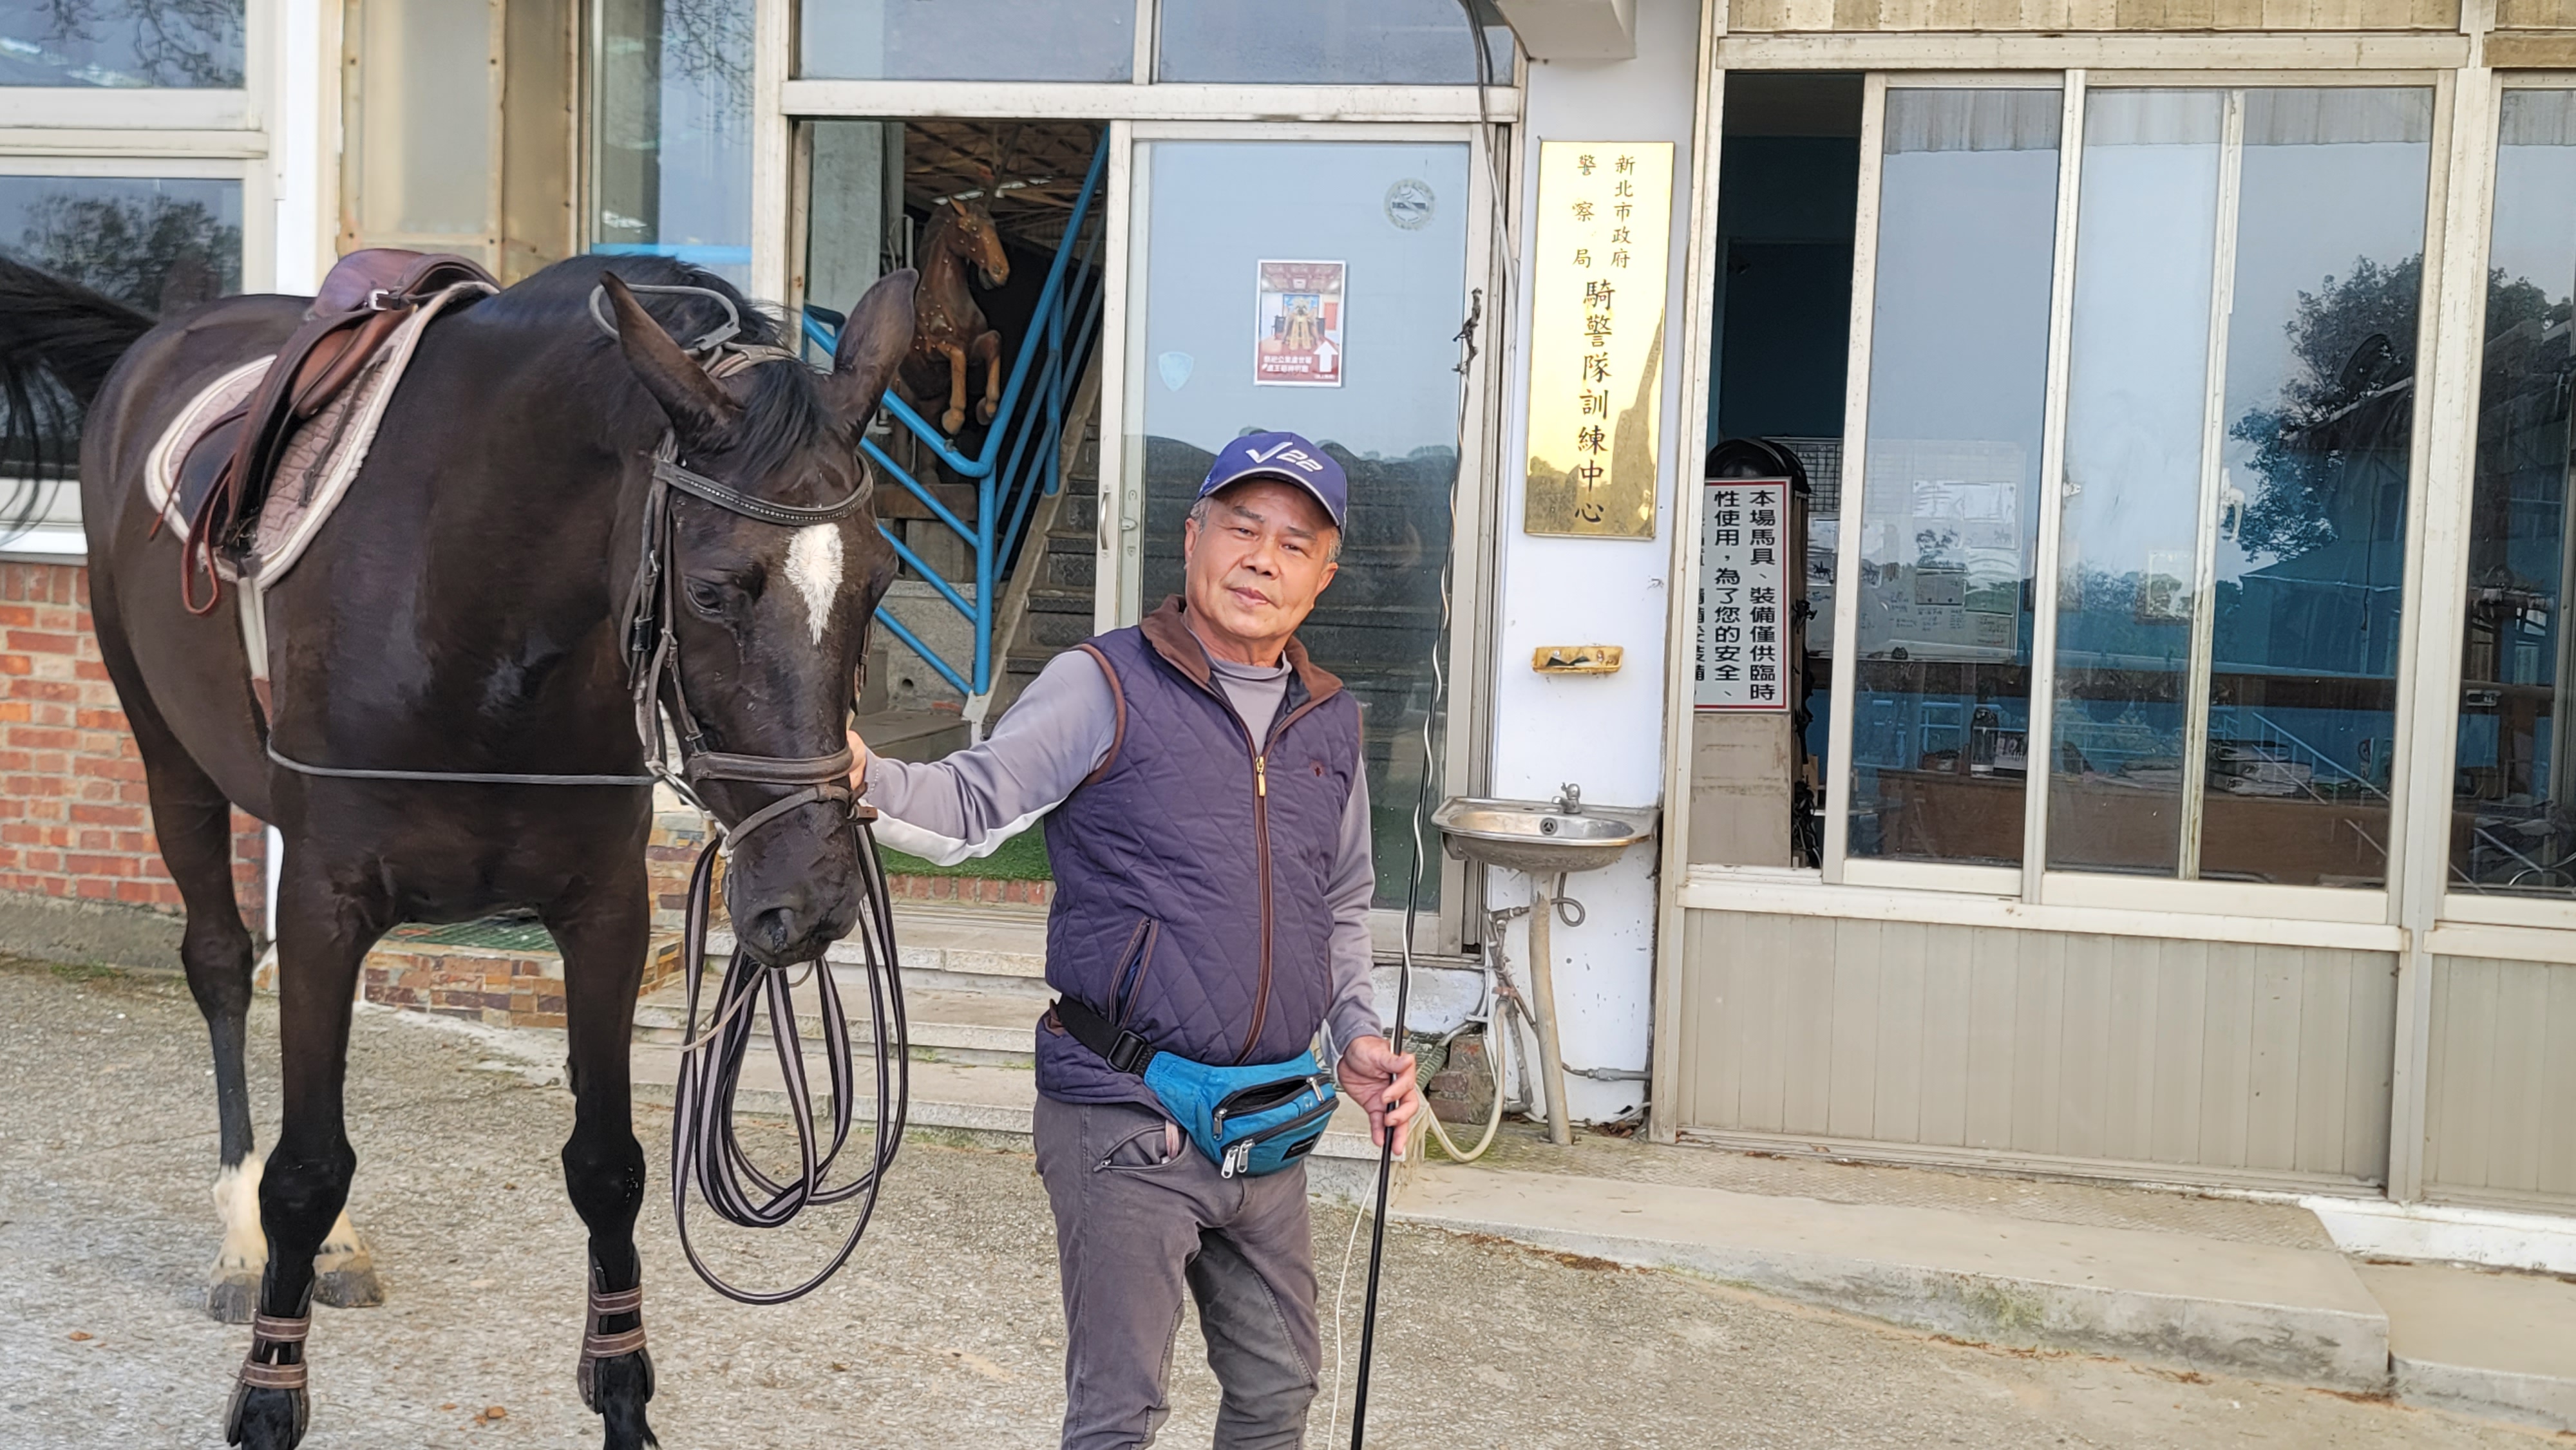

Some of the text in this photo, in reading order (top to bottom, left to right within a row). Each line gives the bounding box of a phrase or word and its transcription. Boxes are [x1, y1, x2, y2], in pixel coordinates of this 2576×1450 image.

[1572, 154, 1596, 269] 警察局
[1611, 154, 1636, 269] 新北市政府
[1575, 278, 1616, 523] 騎警隊訓練中心
[1748, 490, 1776, 701] 本場馬具、裝備僅供臨時
